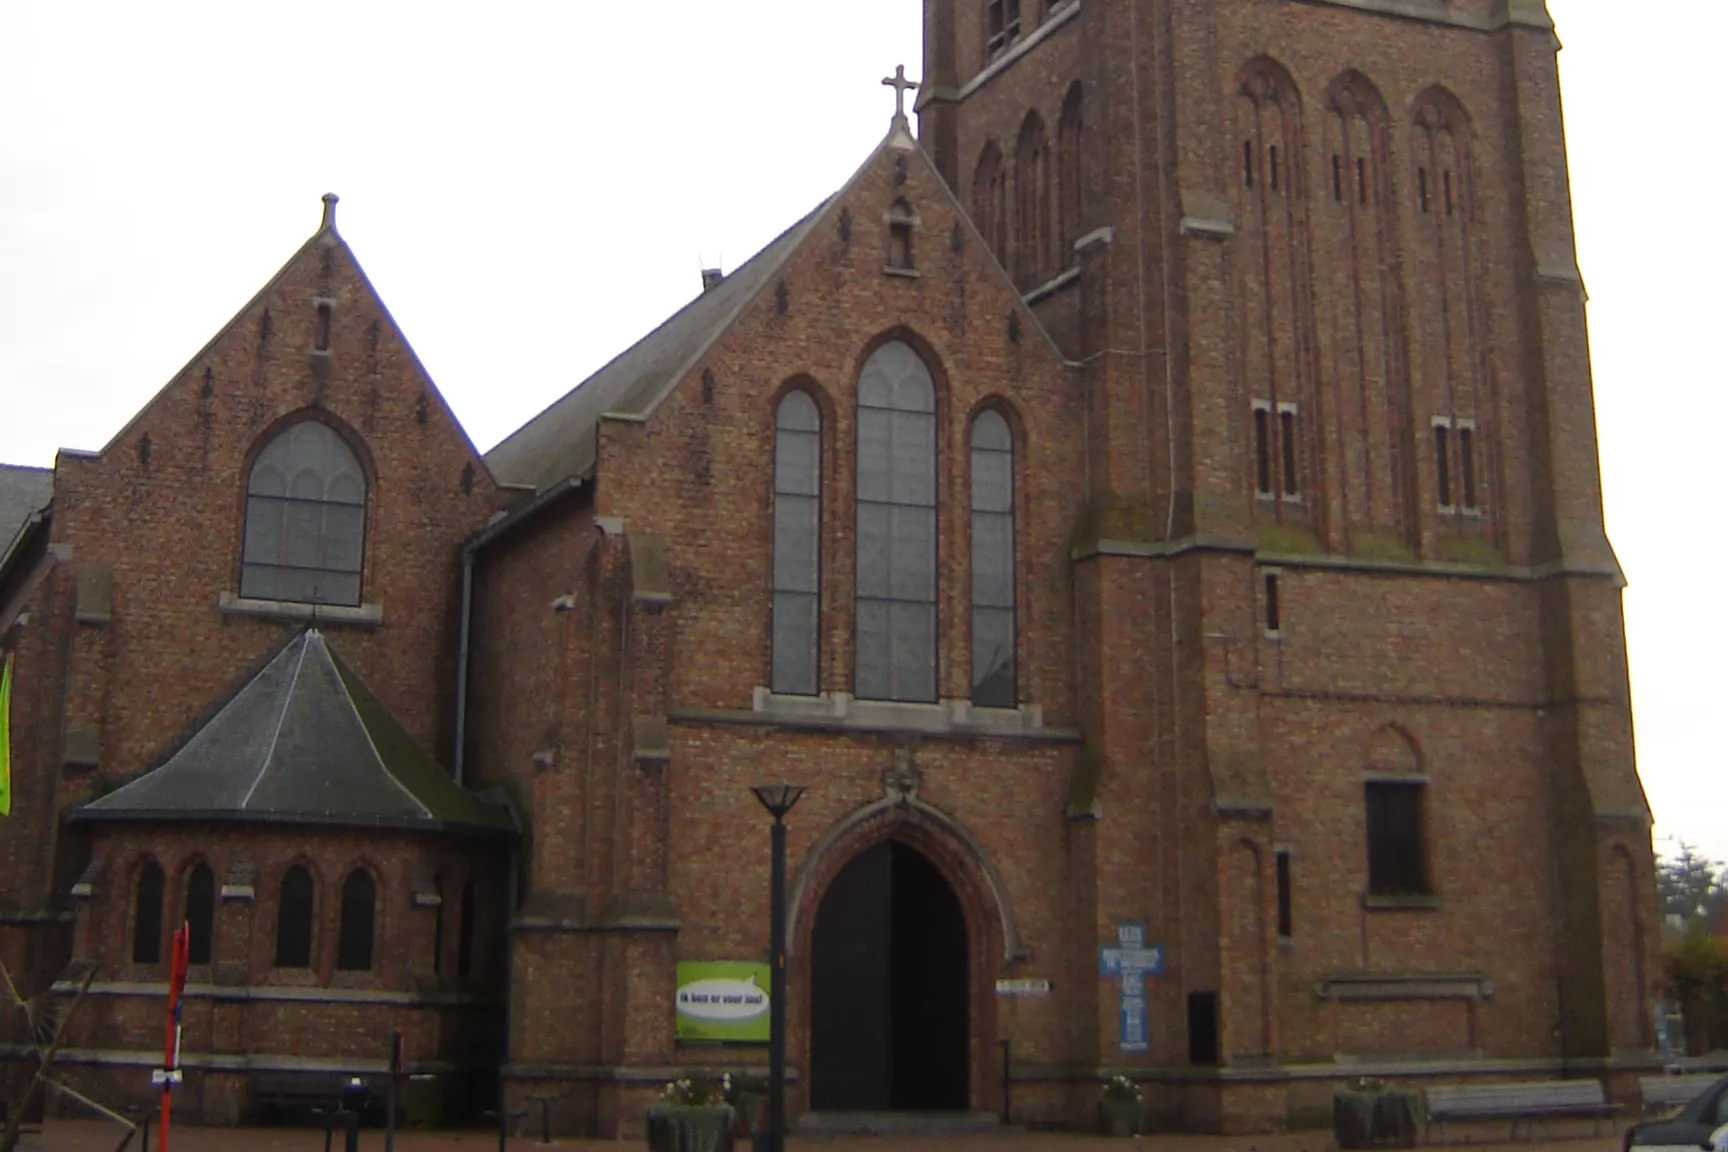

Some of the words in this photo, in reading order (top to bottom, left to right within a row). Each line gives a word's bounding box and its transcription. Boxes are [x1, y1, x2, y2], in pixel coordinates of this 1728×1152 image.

[691, 992, 708, 1003] ben
[711, 994, 720, 1003] er
[723, 994, 743, 1004] voor
